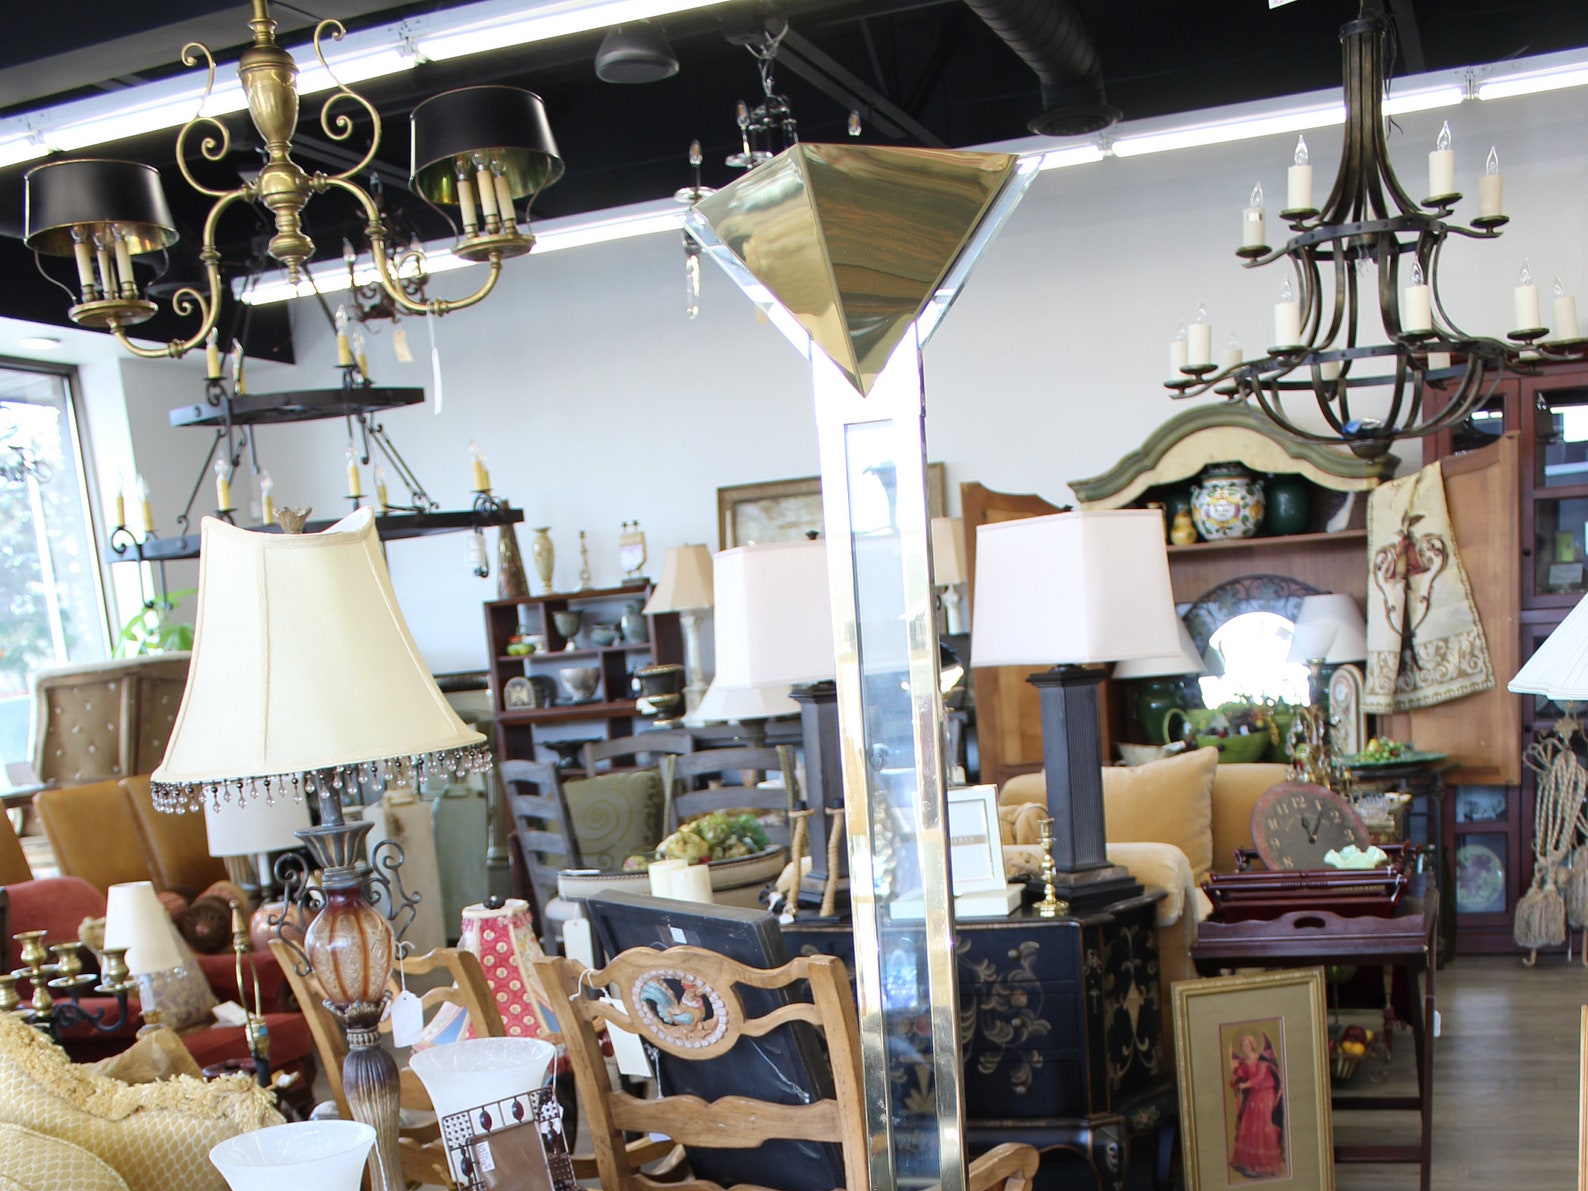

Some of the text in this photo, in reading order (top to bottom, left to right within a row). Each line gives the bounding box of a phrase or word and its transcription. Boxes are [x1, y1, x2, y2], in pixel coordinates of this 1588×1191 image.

[1291, 795, 1307, 809] 12
[1315, 799, 1322, 811] 1
[1276, 803, 1289, 815] 11
[1331, 810, 1342, 823] 2
[1267, 818, 1280, 831] 10
[1344, 828, 1355, 842] 3
[1270, 837, 1281, 849] 9
